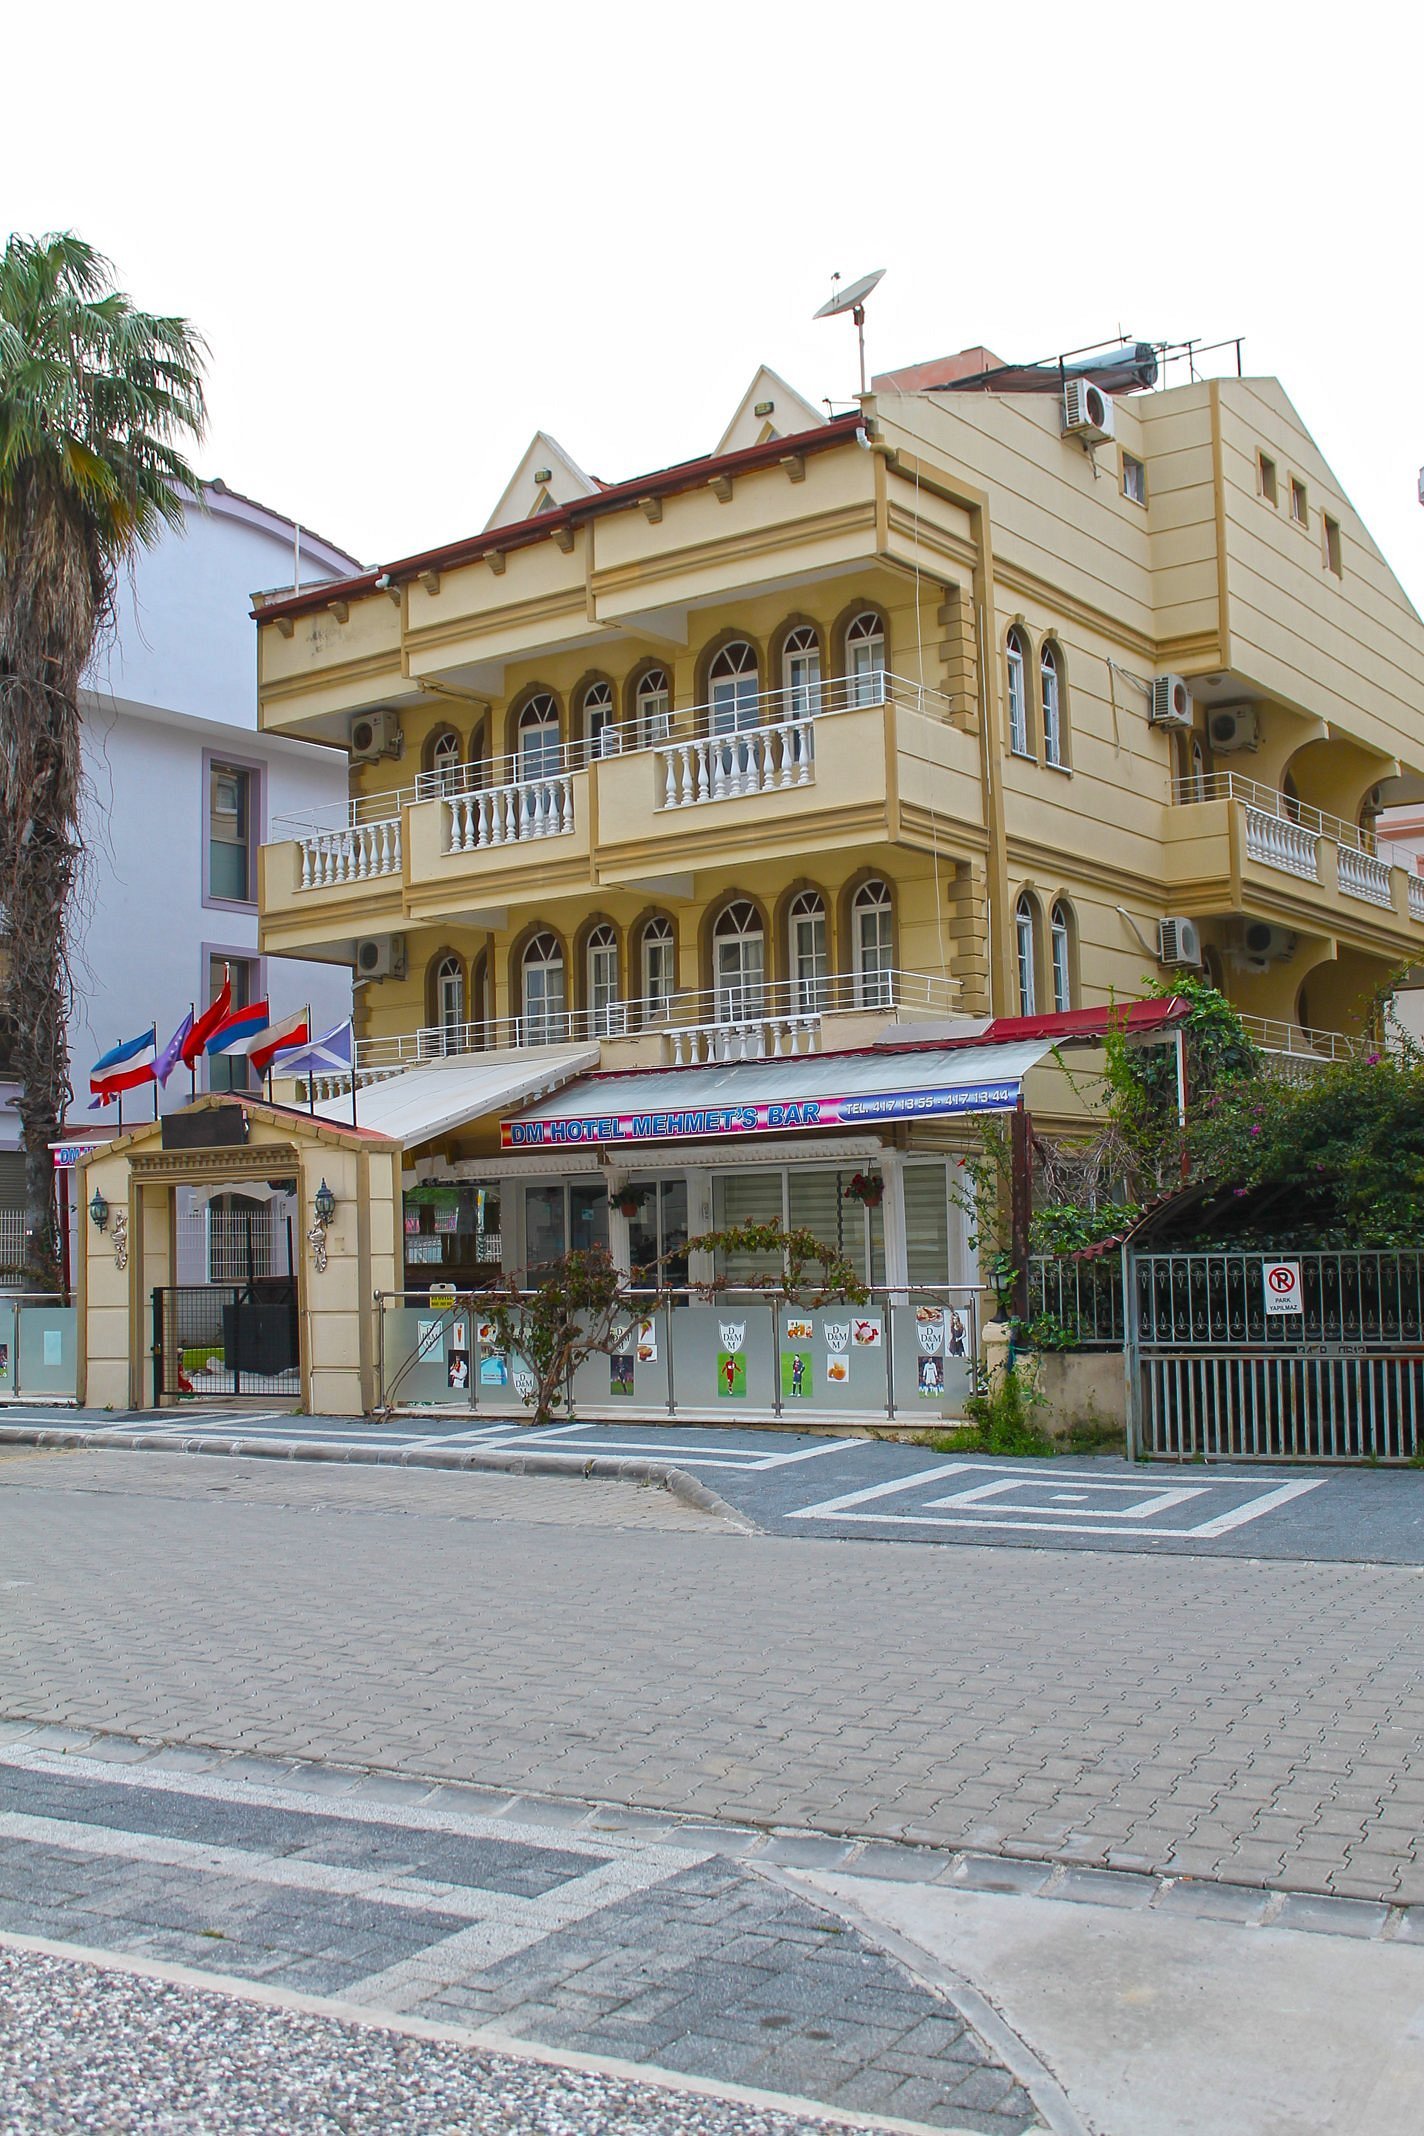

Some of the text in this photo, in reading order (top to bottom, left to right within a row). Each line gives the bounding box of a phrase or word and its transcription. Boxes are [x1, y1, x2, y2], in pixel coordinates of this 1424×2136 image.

[846, 1103, 869, 1114] TEL.
[873, 1100, 896, 1112] 417
[901, 1098, 914, 1110] 13
[918, 1096, 934, 1109] 55
[945, 1093, 969, 1105] 417
[974, 1091, 988, 1103] 13
[992, 1089, 1009, 1101] 44
[511, 1102, 821, 1144] DM HOTEL MEHMET'S BAR
